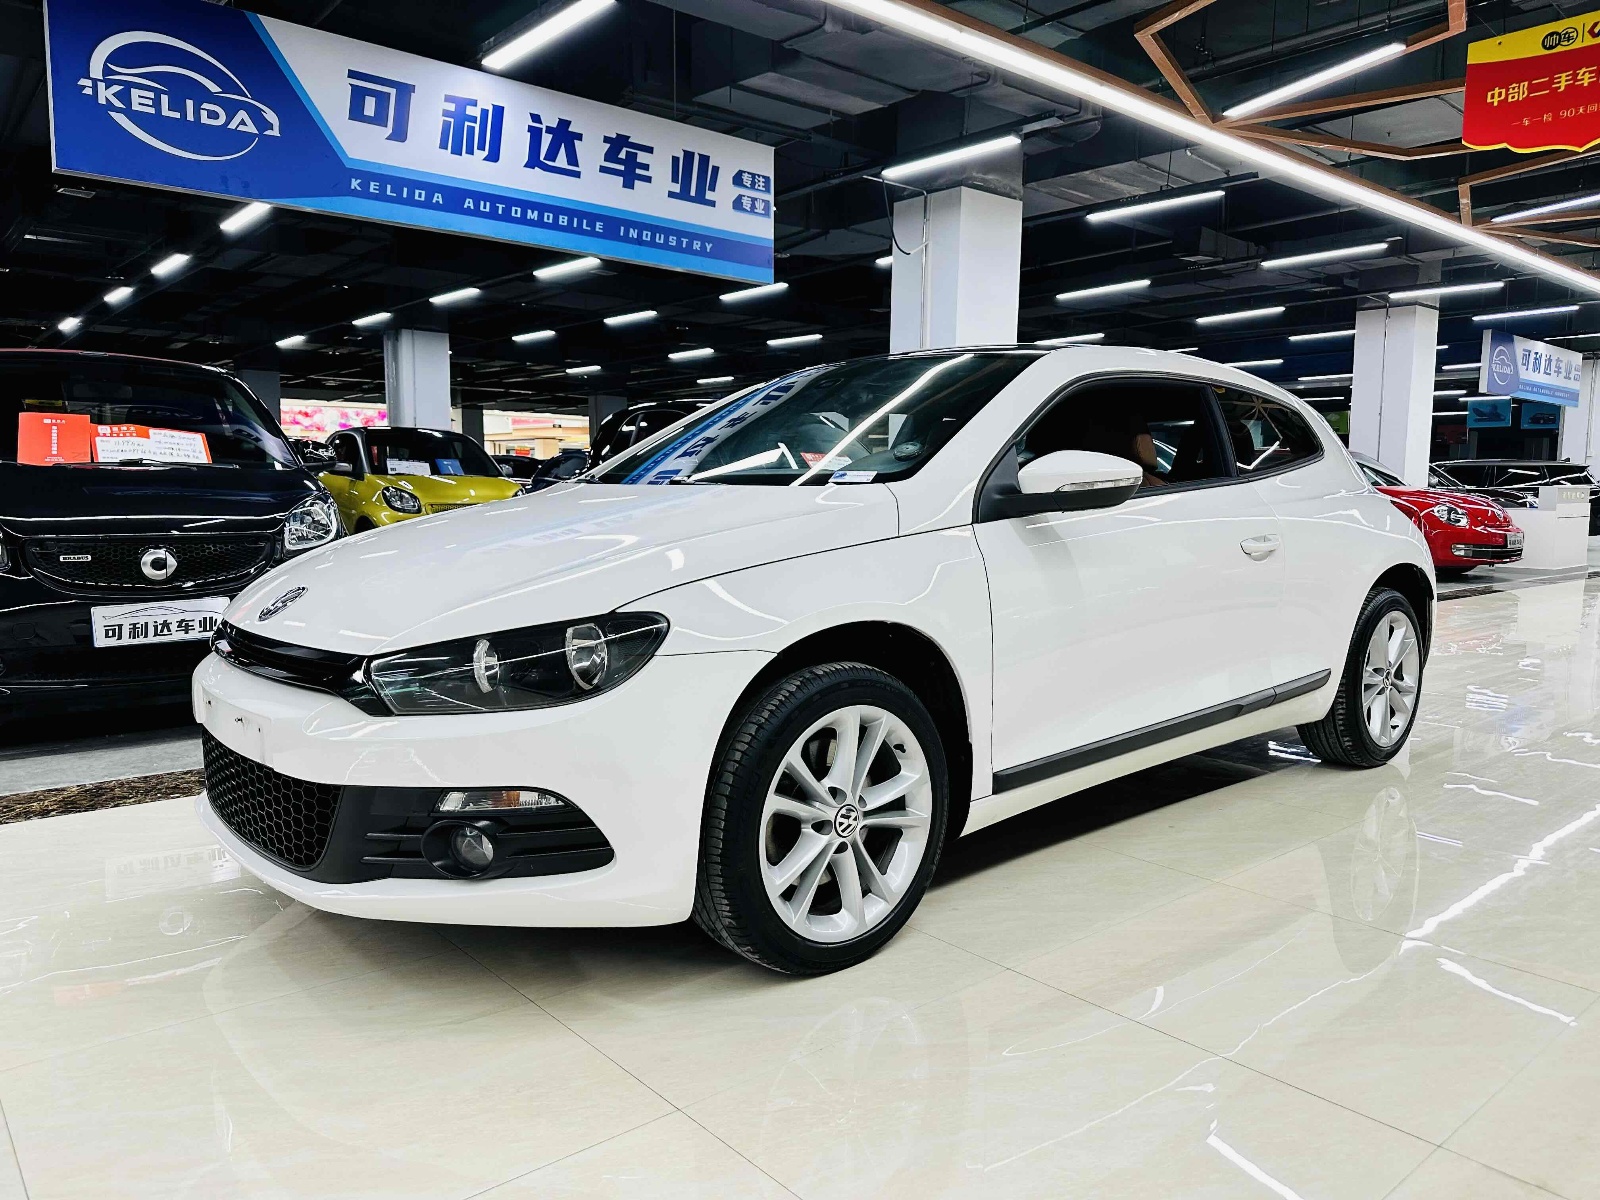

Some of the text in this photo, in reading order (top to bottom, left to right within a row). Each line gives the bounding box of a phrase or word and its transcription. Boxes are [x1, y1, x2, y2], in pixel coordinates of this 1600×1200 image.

[1487, 66, 1600, 107] 中部二手车
[97, 81, 259, 134] KELIDA
[1560, 102, 1600, 119] 90天回
[347, 69, 720, 208] 可利达车业
[742, 172, 766, 191] 专注
[351, 178, 713, 252] KELIDA AUTOMOBILE INDUSTRY
[742, 195, 766, 214] 专业
[1521, 348, 1573, 381] 可利达车业
[103, 616, 218, 641] 可利达车业
